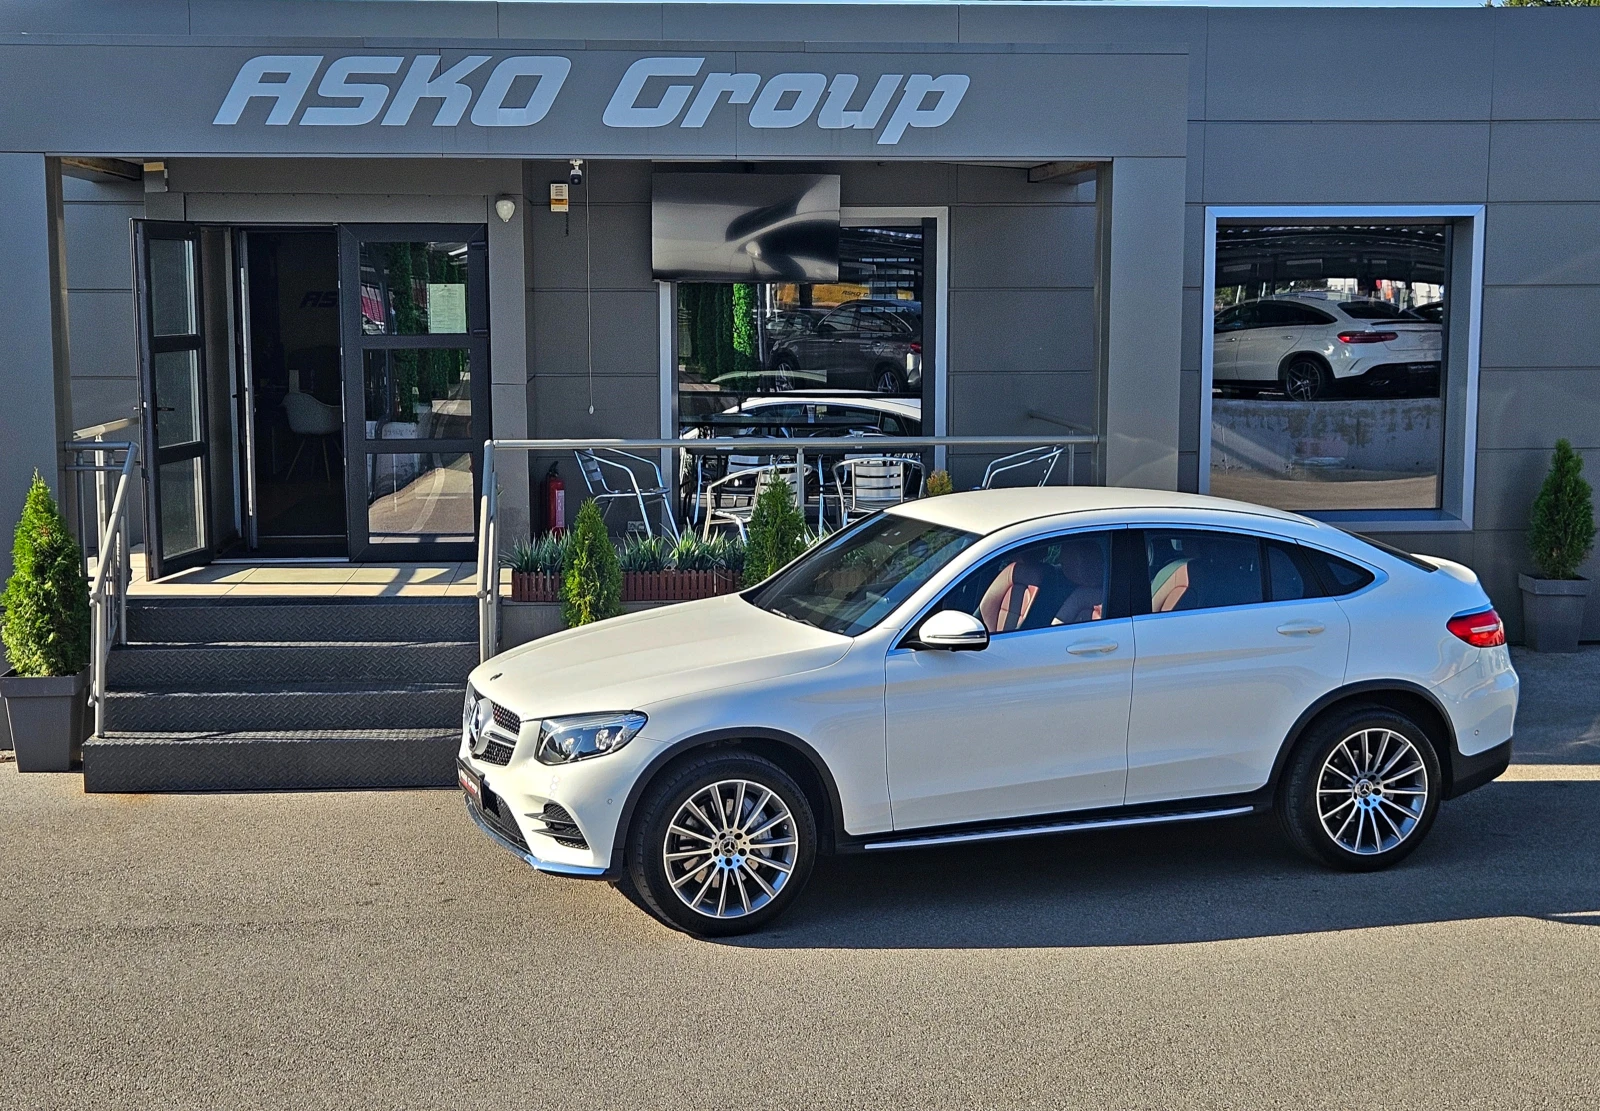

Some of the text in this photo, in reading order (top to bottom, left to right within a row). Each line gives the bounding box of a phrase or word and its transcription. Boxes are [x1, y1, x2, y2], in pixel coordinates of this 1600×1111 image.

[213, 55, 970, 145] ASKO Group
[299, 291, 337, 308] AS
